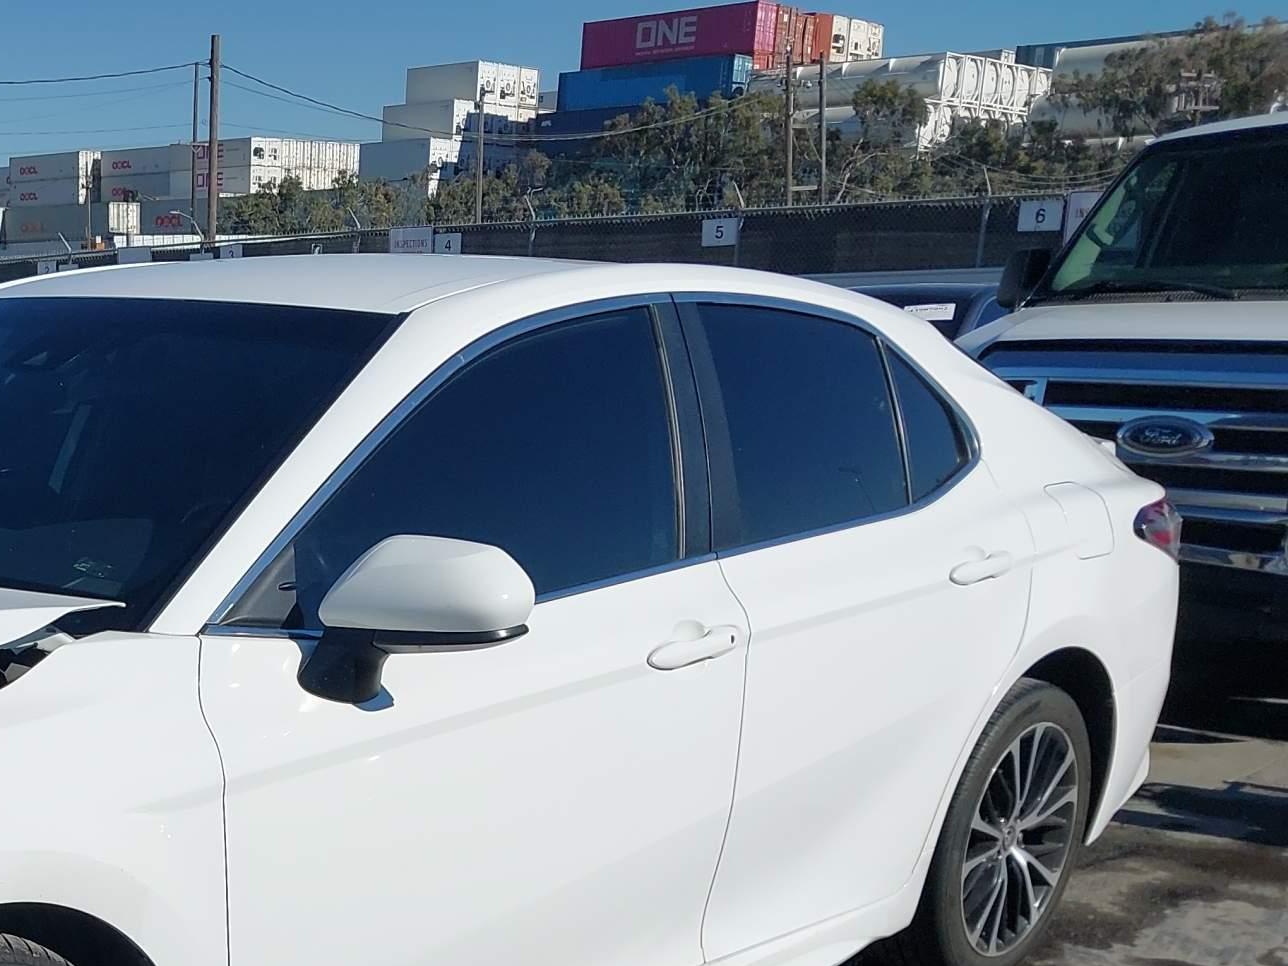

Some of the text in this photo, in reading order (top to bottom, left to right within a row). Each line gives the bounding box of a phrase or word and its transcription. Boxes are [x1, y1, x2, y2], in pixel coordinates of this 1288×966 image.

[636, 15, 698, 48] ONE
[195, 143, 224, 159] OE
[196, 172, 224, 187] OE
[1035, 208, 1046, 223] 6
[715, 225, 724, 239] 5
[444, 240, 451, 251] 4
[1143, 428, 1182, 445] Ford
